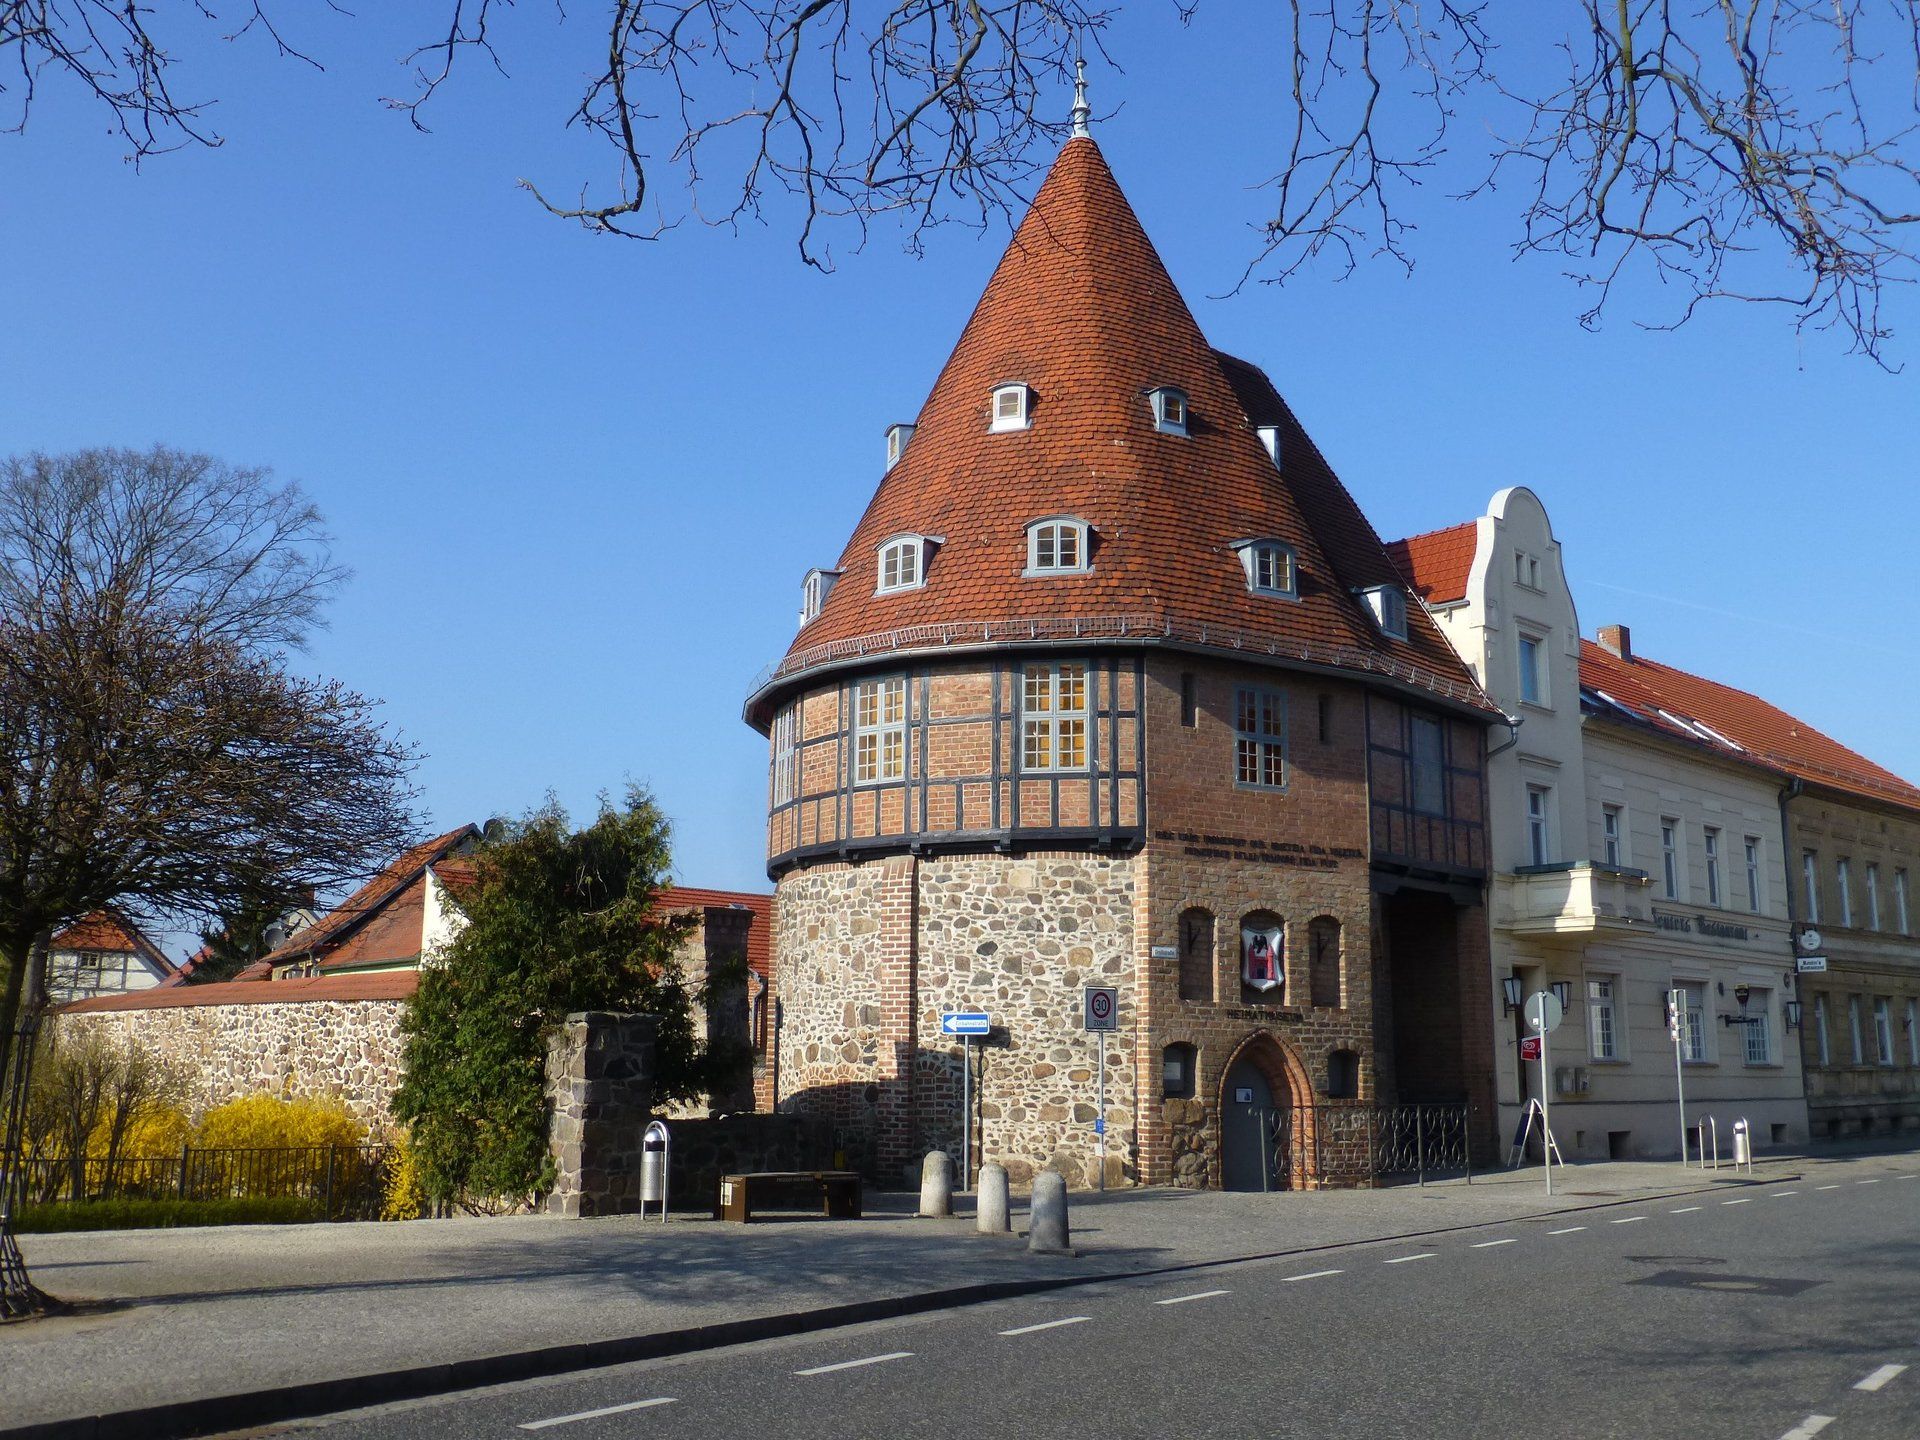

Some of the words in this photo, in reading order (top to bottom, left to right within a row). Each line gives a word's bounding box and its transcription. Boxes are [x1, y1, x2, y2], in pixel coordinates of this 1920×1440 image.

[1095, 999, 1107, 1012] 30
[1226, 1008, 1304, 1023] HEIMATMUSEUM
[1093, 1019, 1109, 1027] ZONE
